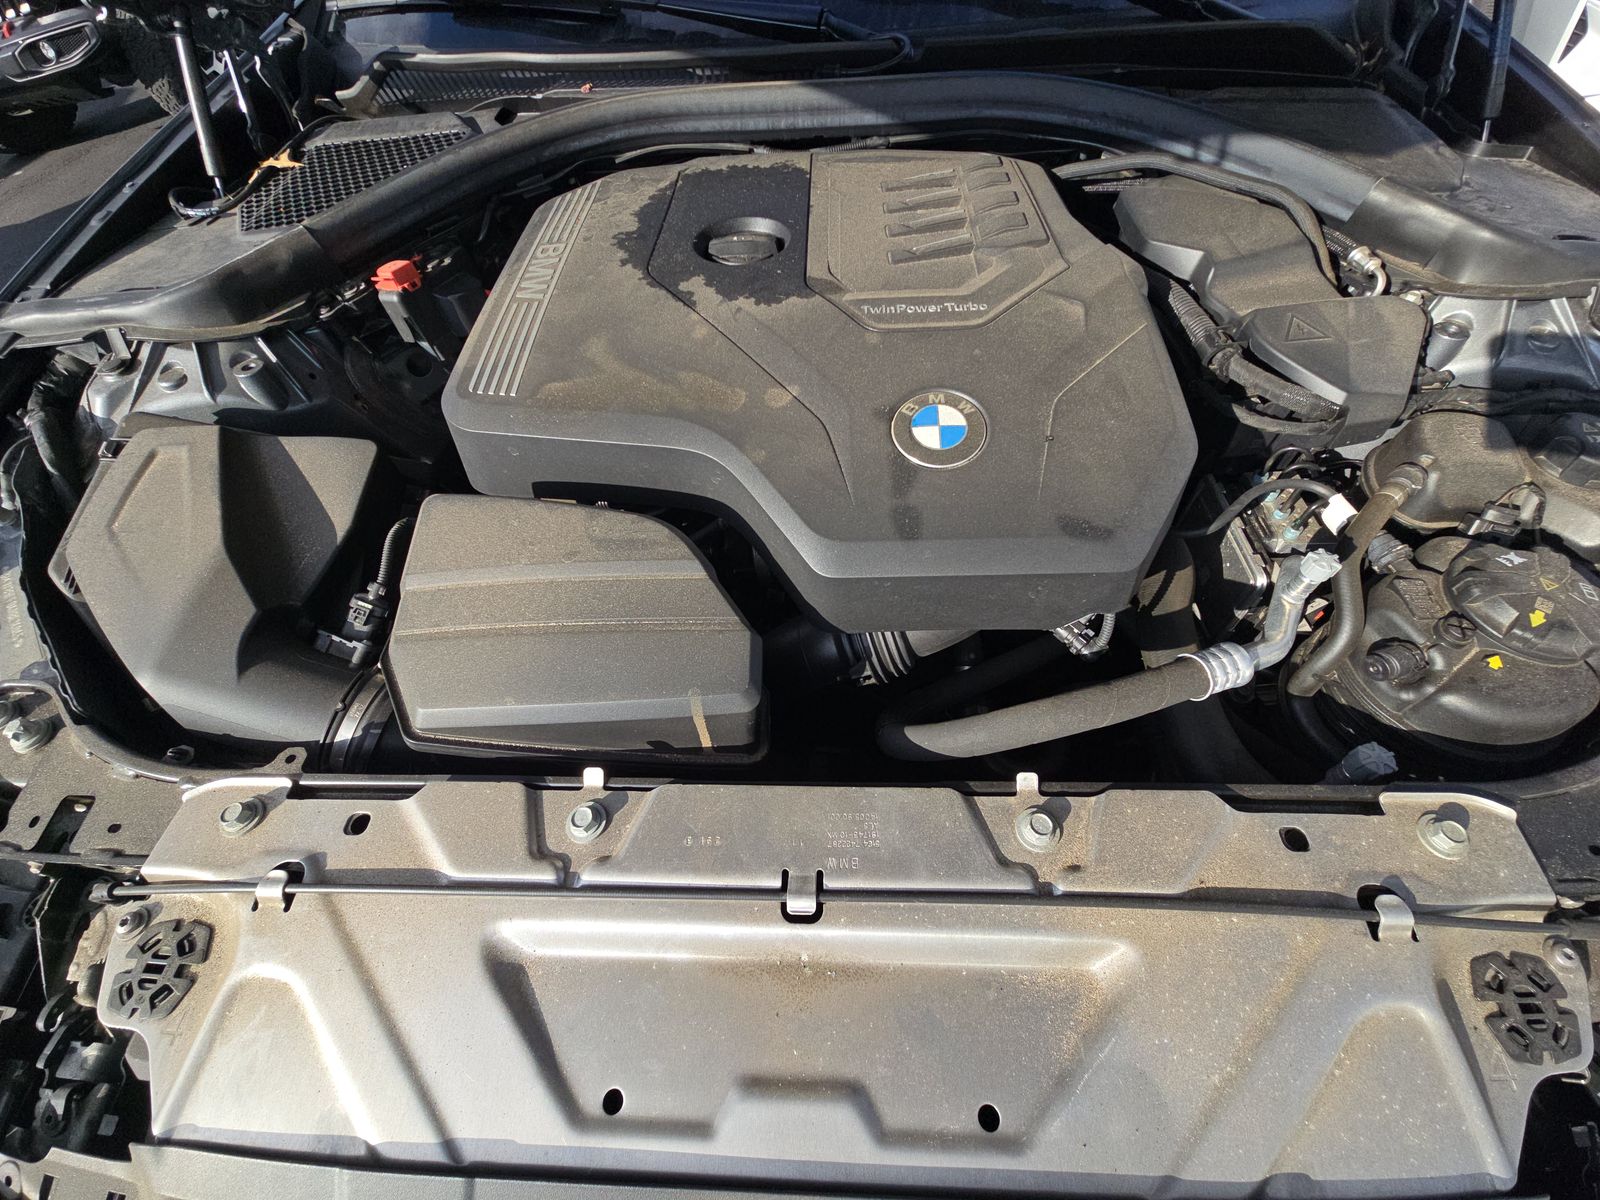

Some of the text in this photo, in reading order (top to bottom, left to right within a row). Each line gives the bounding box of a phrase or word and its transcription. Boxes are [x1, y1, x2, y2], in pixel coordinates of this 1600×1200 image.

[516, 243, 568, 299] BMW
[944, 301, 989, 313] Turbo
[901, 393, 976, 417] BMW
[827, 857, 859, 870] BMW
